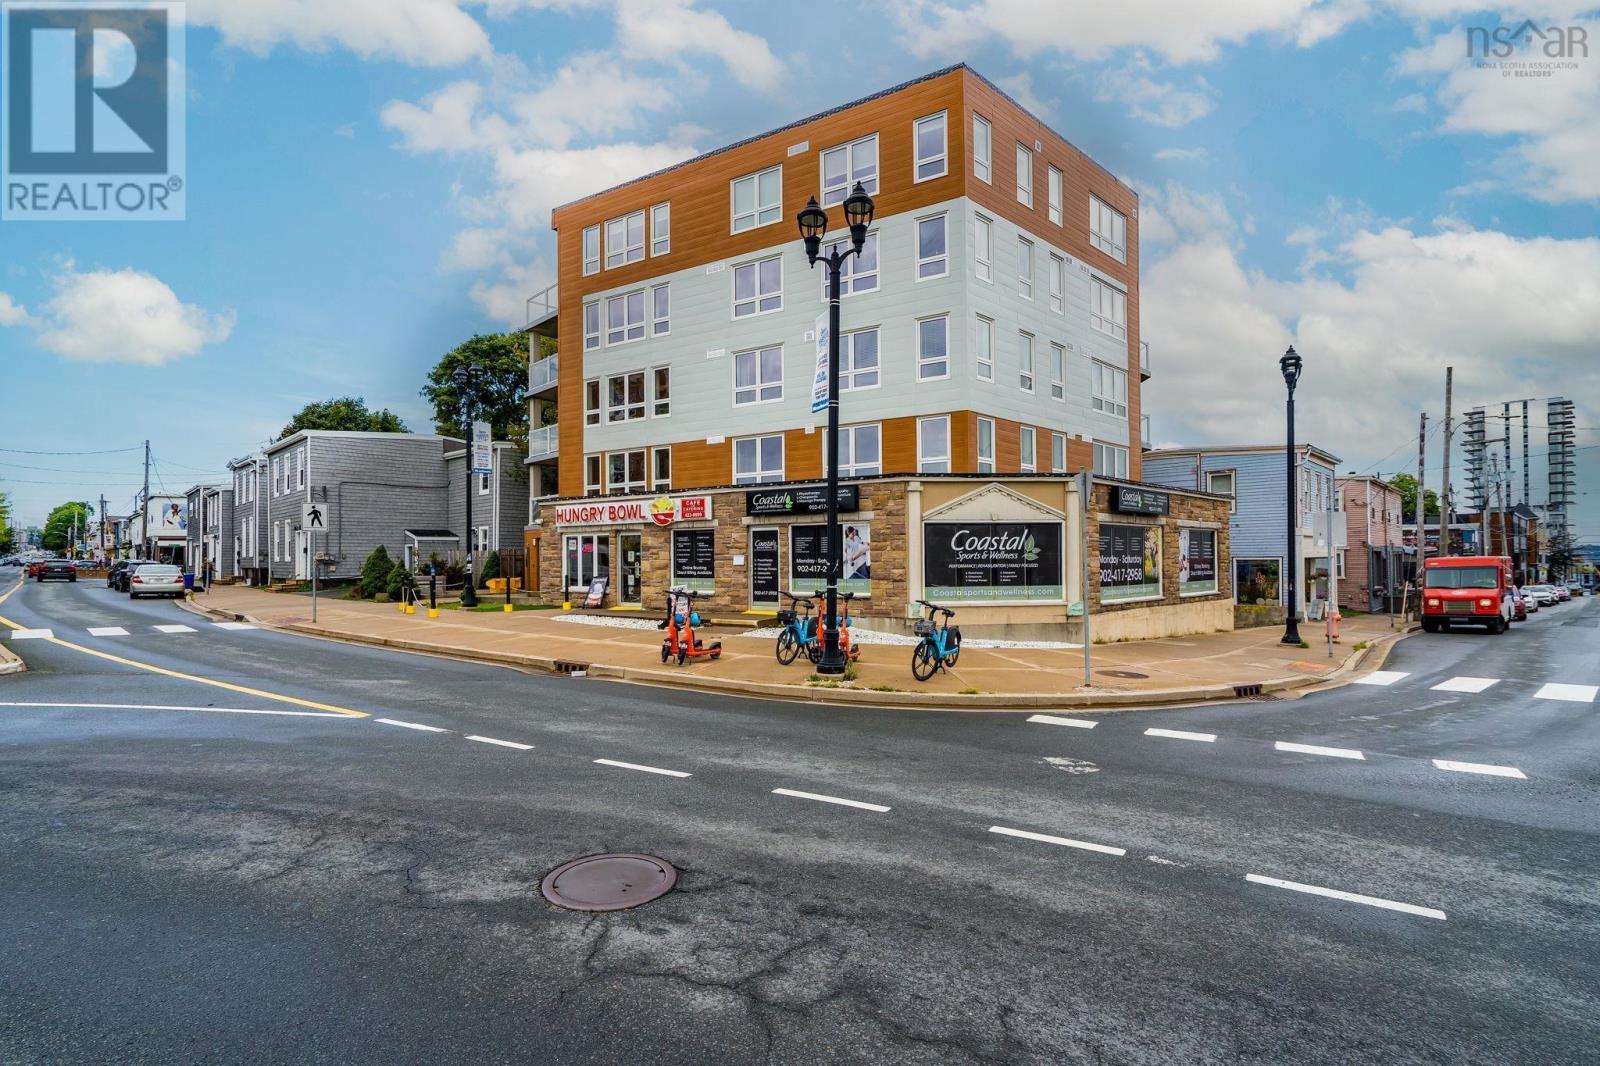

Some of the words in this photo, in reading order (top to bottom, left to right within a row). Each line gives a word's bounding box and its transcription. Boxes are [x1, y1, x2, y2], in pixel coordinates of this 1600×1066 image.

[753, 491, 787, 505] Coastal
[556, 506, 605, 524] HUNGRY
[608, 503, 647, 520] BOWL
[951, 529, 1028, 551] Coastal
[956, 551, 981, 561] Sports
[981, 551, 989, 560] &
[989, 550, 1018, 560] Wellness
[1122, 554, 1142, 565] Saturday
[933, 587, 1054, 597] Coastasportsandwellness.com
